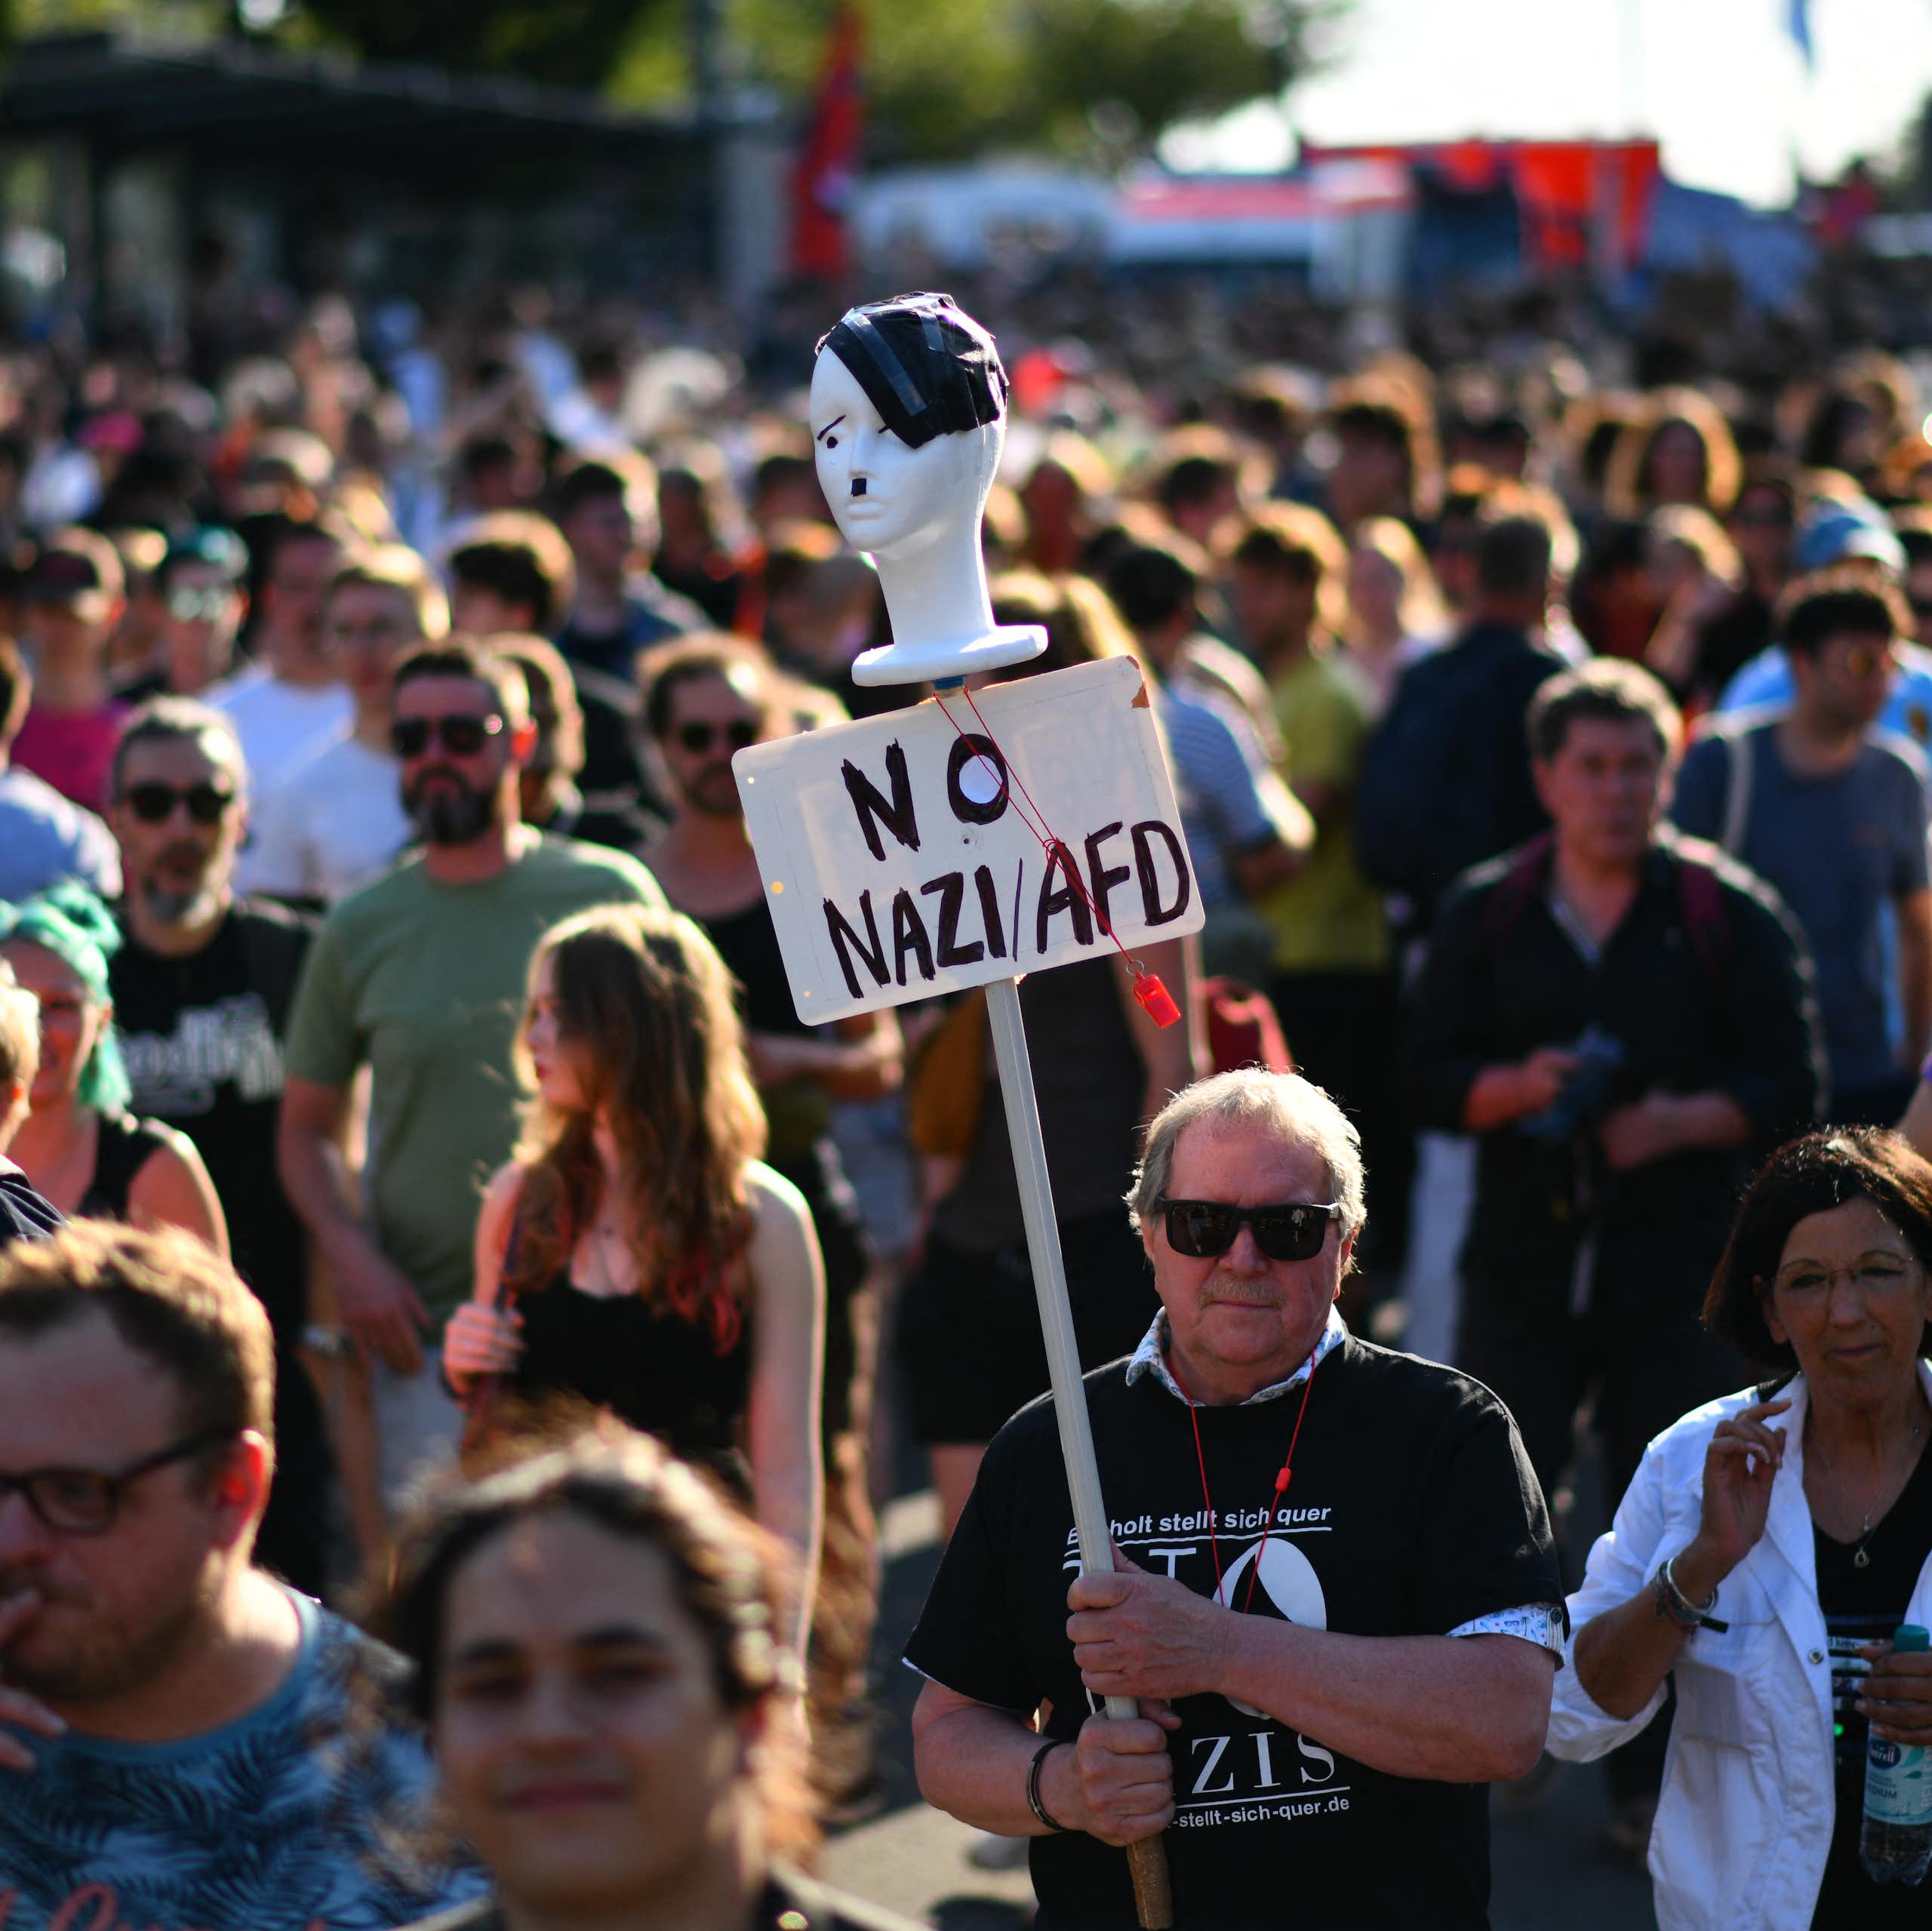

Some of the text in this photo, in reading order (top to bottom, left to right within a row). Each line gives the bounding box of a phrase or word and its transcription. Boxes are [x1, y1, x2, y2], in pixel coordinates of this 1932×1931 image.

[841, 733, 1010, 862] NO
[823, 819, 1190, 999] NAZI/AFD
[1067, 1507, 1331, 1545] Bholt stellt sich quer
[1191, 1731, 1335, 1794] ZIS
[1168, 1796, 1350, 1828] -stellt-sich-quer.de
